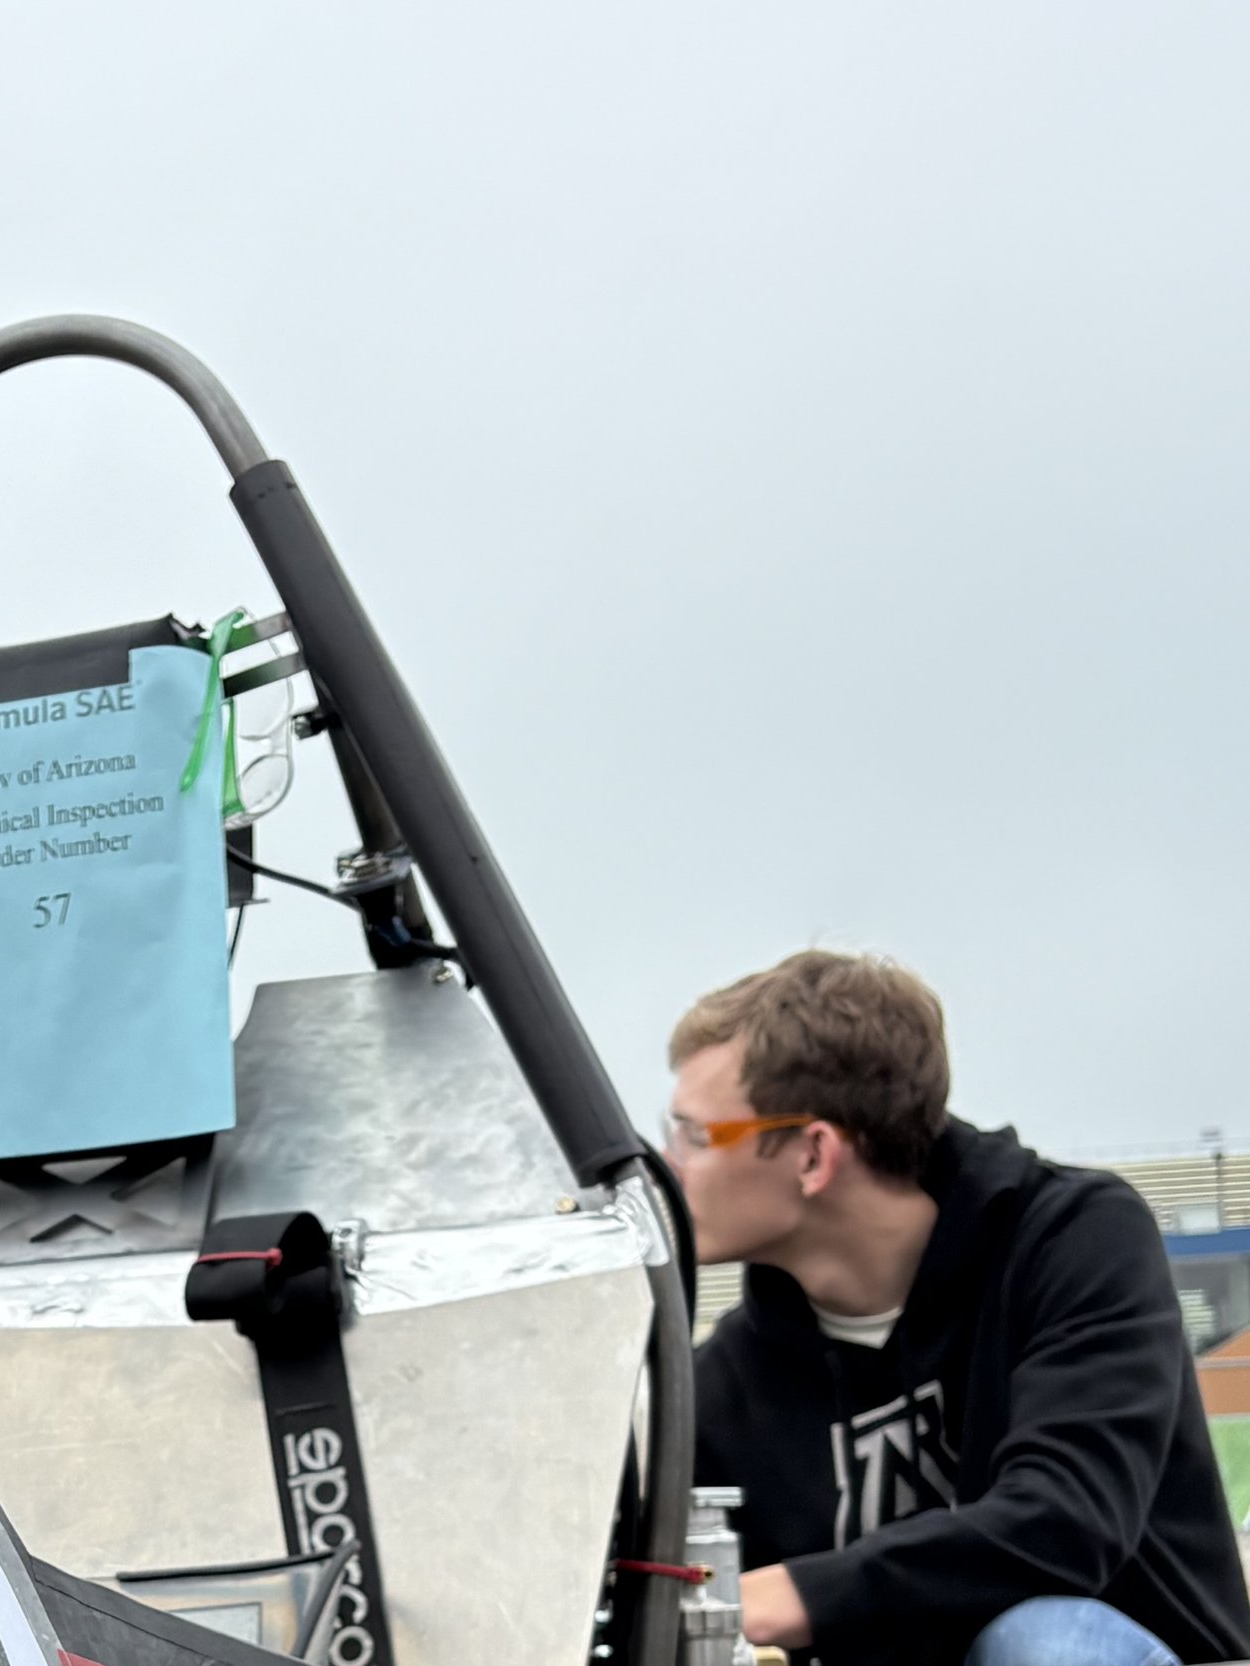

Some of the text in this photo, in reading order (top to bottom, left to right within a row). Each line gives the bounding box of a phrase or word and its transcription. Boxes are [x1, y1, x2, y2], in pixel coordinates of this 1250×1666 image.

[74, 682, 137, 718] SAE
[16, 763, 44, 787] of
[46, 752, 137, 781] Arizona
[47, 792, 165, 830] Inspection
[39, 832, 133, 861] Number
[32, 892, 72, 928] 57
